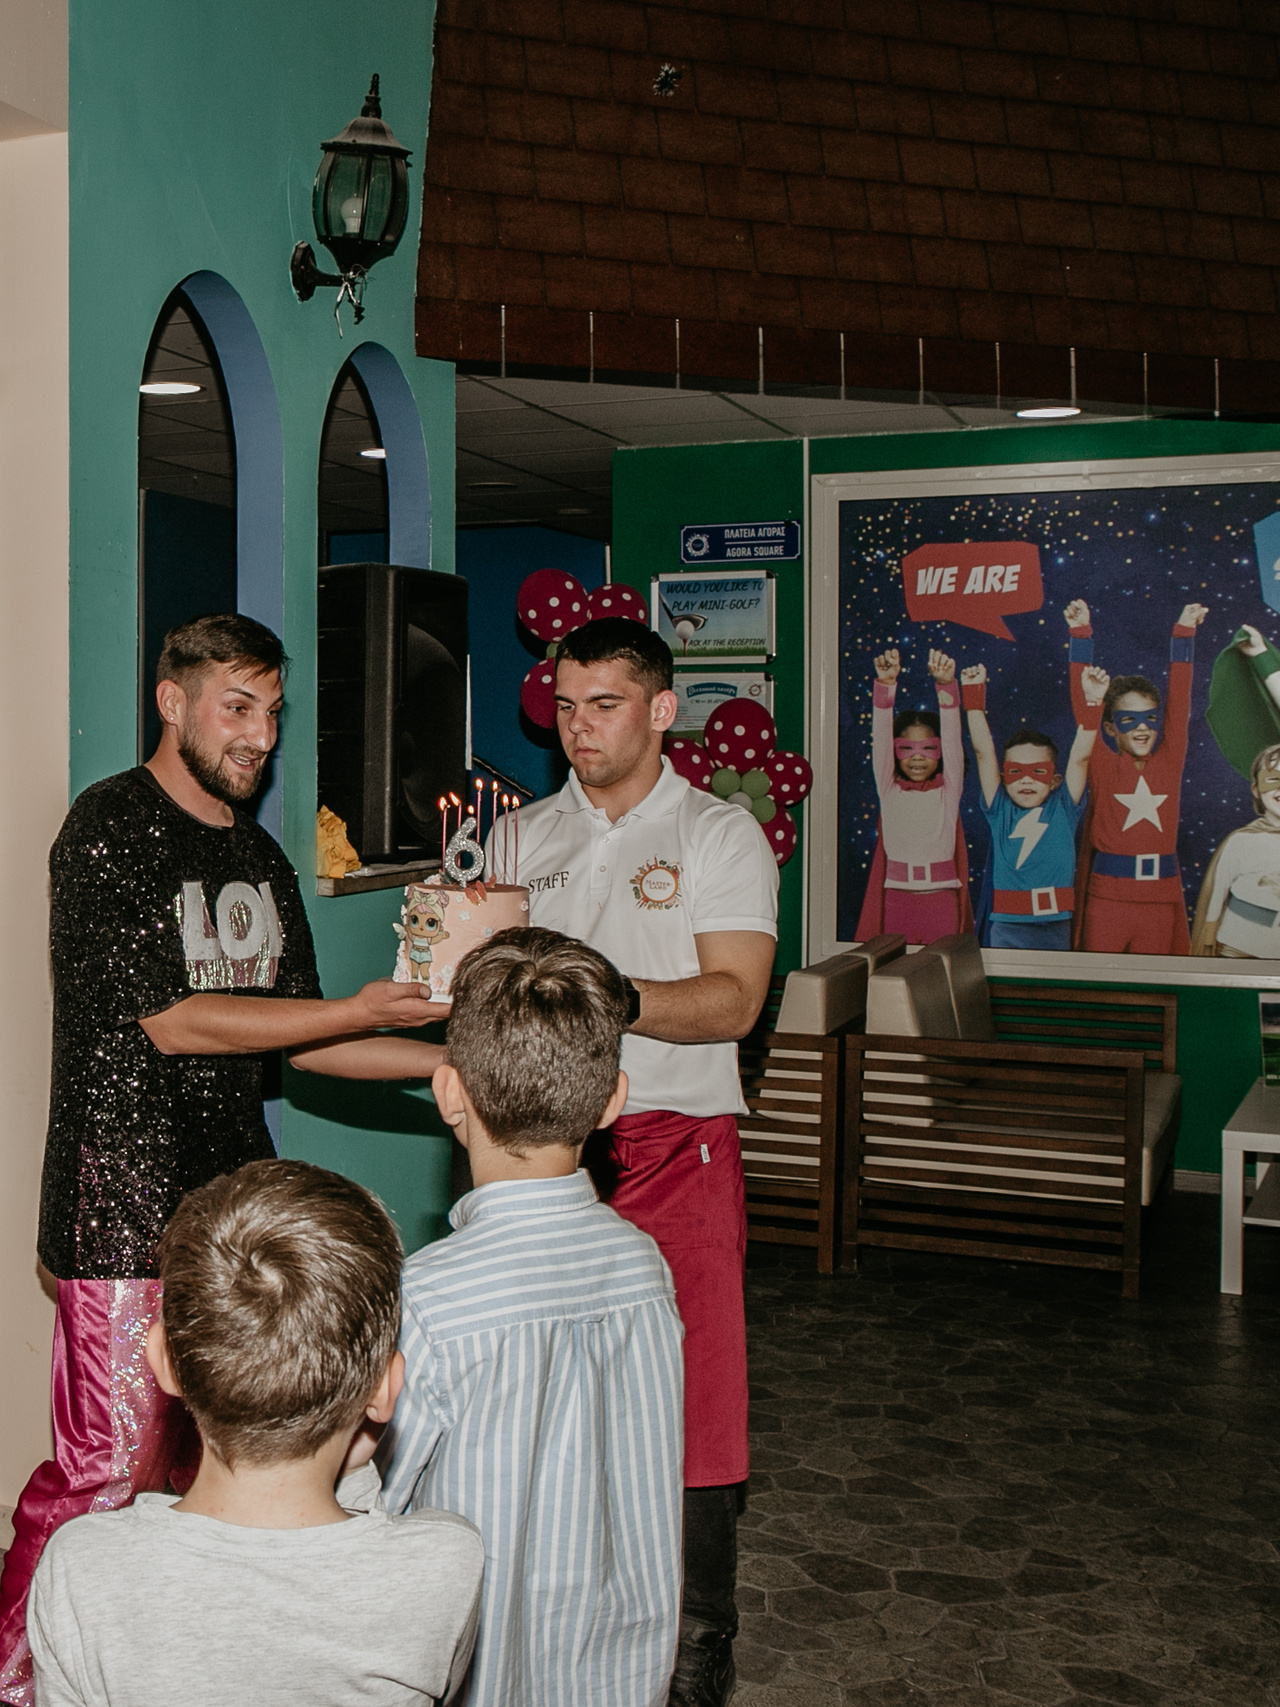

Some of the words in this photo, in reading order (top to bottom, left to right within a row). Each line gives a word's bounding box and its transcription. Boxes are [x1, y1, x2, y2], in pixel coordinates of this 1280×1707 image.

[724, 528, 756, 539] ΠΛΑΤΕΙΑ
[757, 526, 786, 537] ΑΓΟΡΑΣ
[726, 547, 752, 557] AGORA
[753, 545, 784, 557] SQUARE
[916, 566, 958, 596] WE
[962, 564, 1021, 595] ARE
[666, 583, 701, 594] WOULD
[702, 582, 724, 593] YOU
[724, 581, 749, 592] LIKE
[752, 581, 765, 591] TO
[672, 600, 697, 611] PLAY
[697, 598, 761, 610] MINI-GOLF?
[688, 639, 702, 647] ASK
[727, 637, 767, 646] RECEPTION
[445, 816, 486, 882] 6
[528, 870, 570, 895] STAFF
